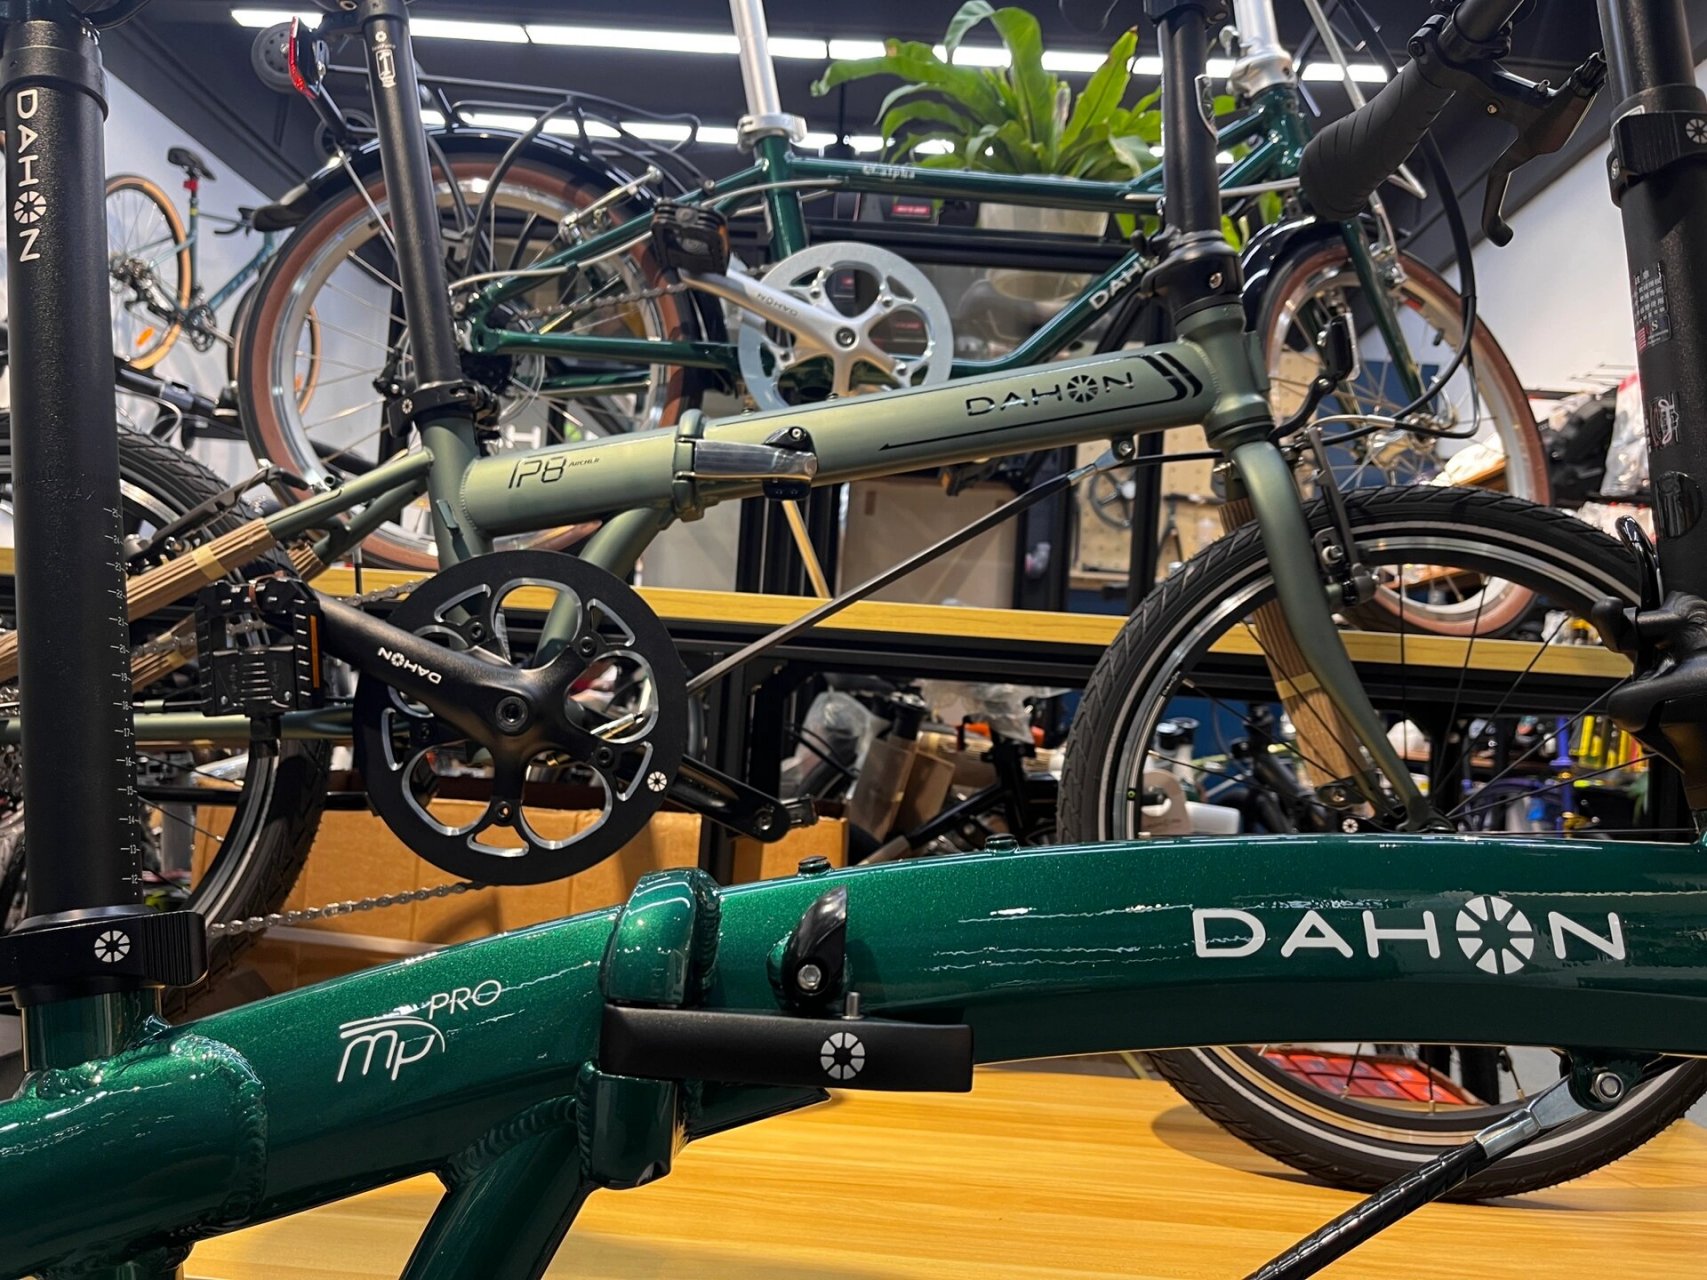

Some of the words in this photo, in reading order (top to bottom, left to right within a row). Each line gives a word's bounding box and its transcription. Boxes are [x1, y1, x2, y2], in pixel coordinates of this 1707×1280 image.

[14, 88, 47, 262] DAHON
[965, 371, 1135, 416] DAHON
[377, 646, 442, 685] DAHON
[1192, 895, 1627, 975] DAHON
[428, 979, 503, 1021] PRO
